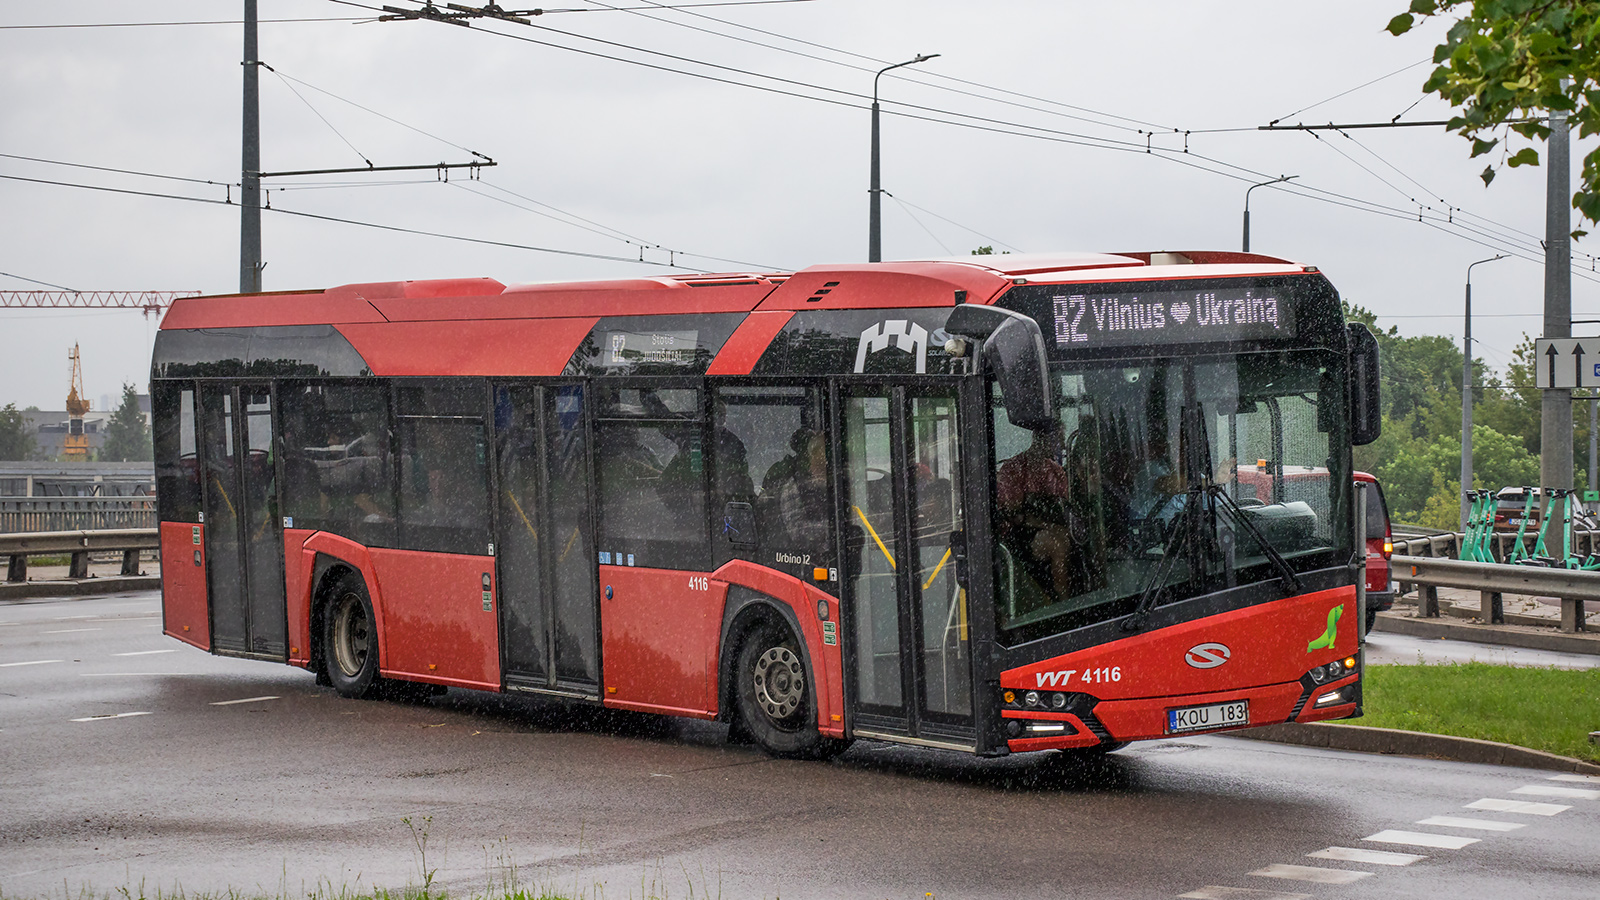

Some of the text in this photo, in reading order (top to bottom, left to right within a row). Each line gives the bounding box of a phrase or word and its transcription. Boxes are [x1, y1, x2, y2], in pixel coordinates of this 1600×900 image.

[1092, 297, 1166, 331] Vilnius
[1195, 292, 1281, 329] Ukrainą
[612, 334, 626, 363] 82
[775, 552, 811, 565] Urbino 12
[688, 576, 709, 592] 4116
[1081, 666, 1122, 684] 4116
[1177, 708, 1209, 727] KOU
[1219, 704, 1244, 722] 183
